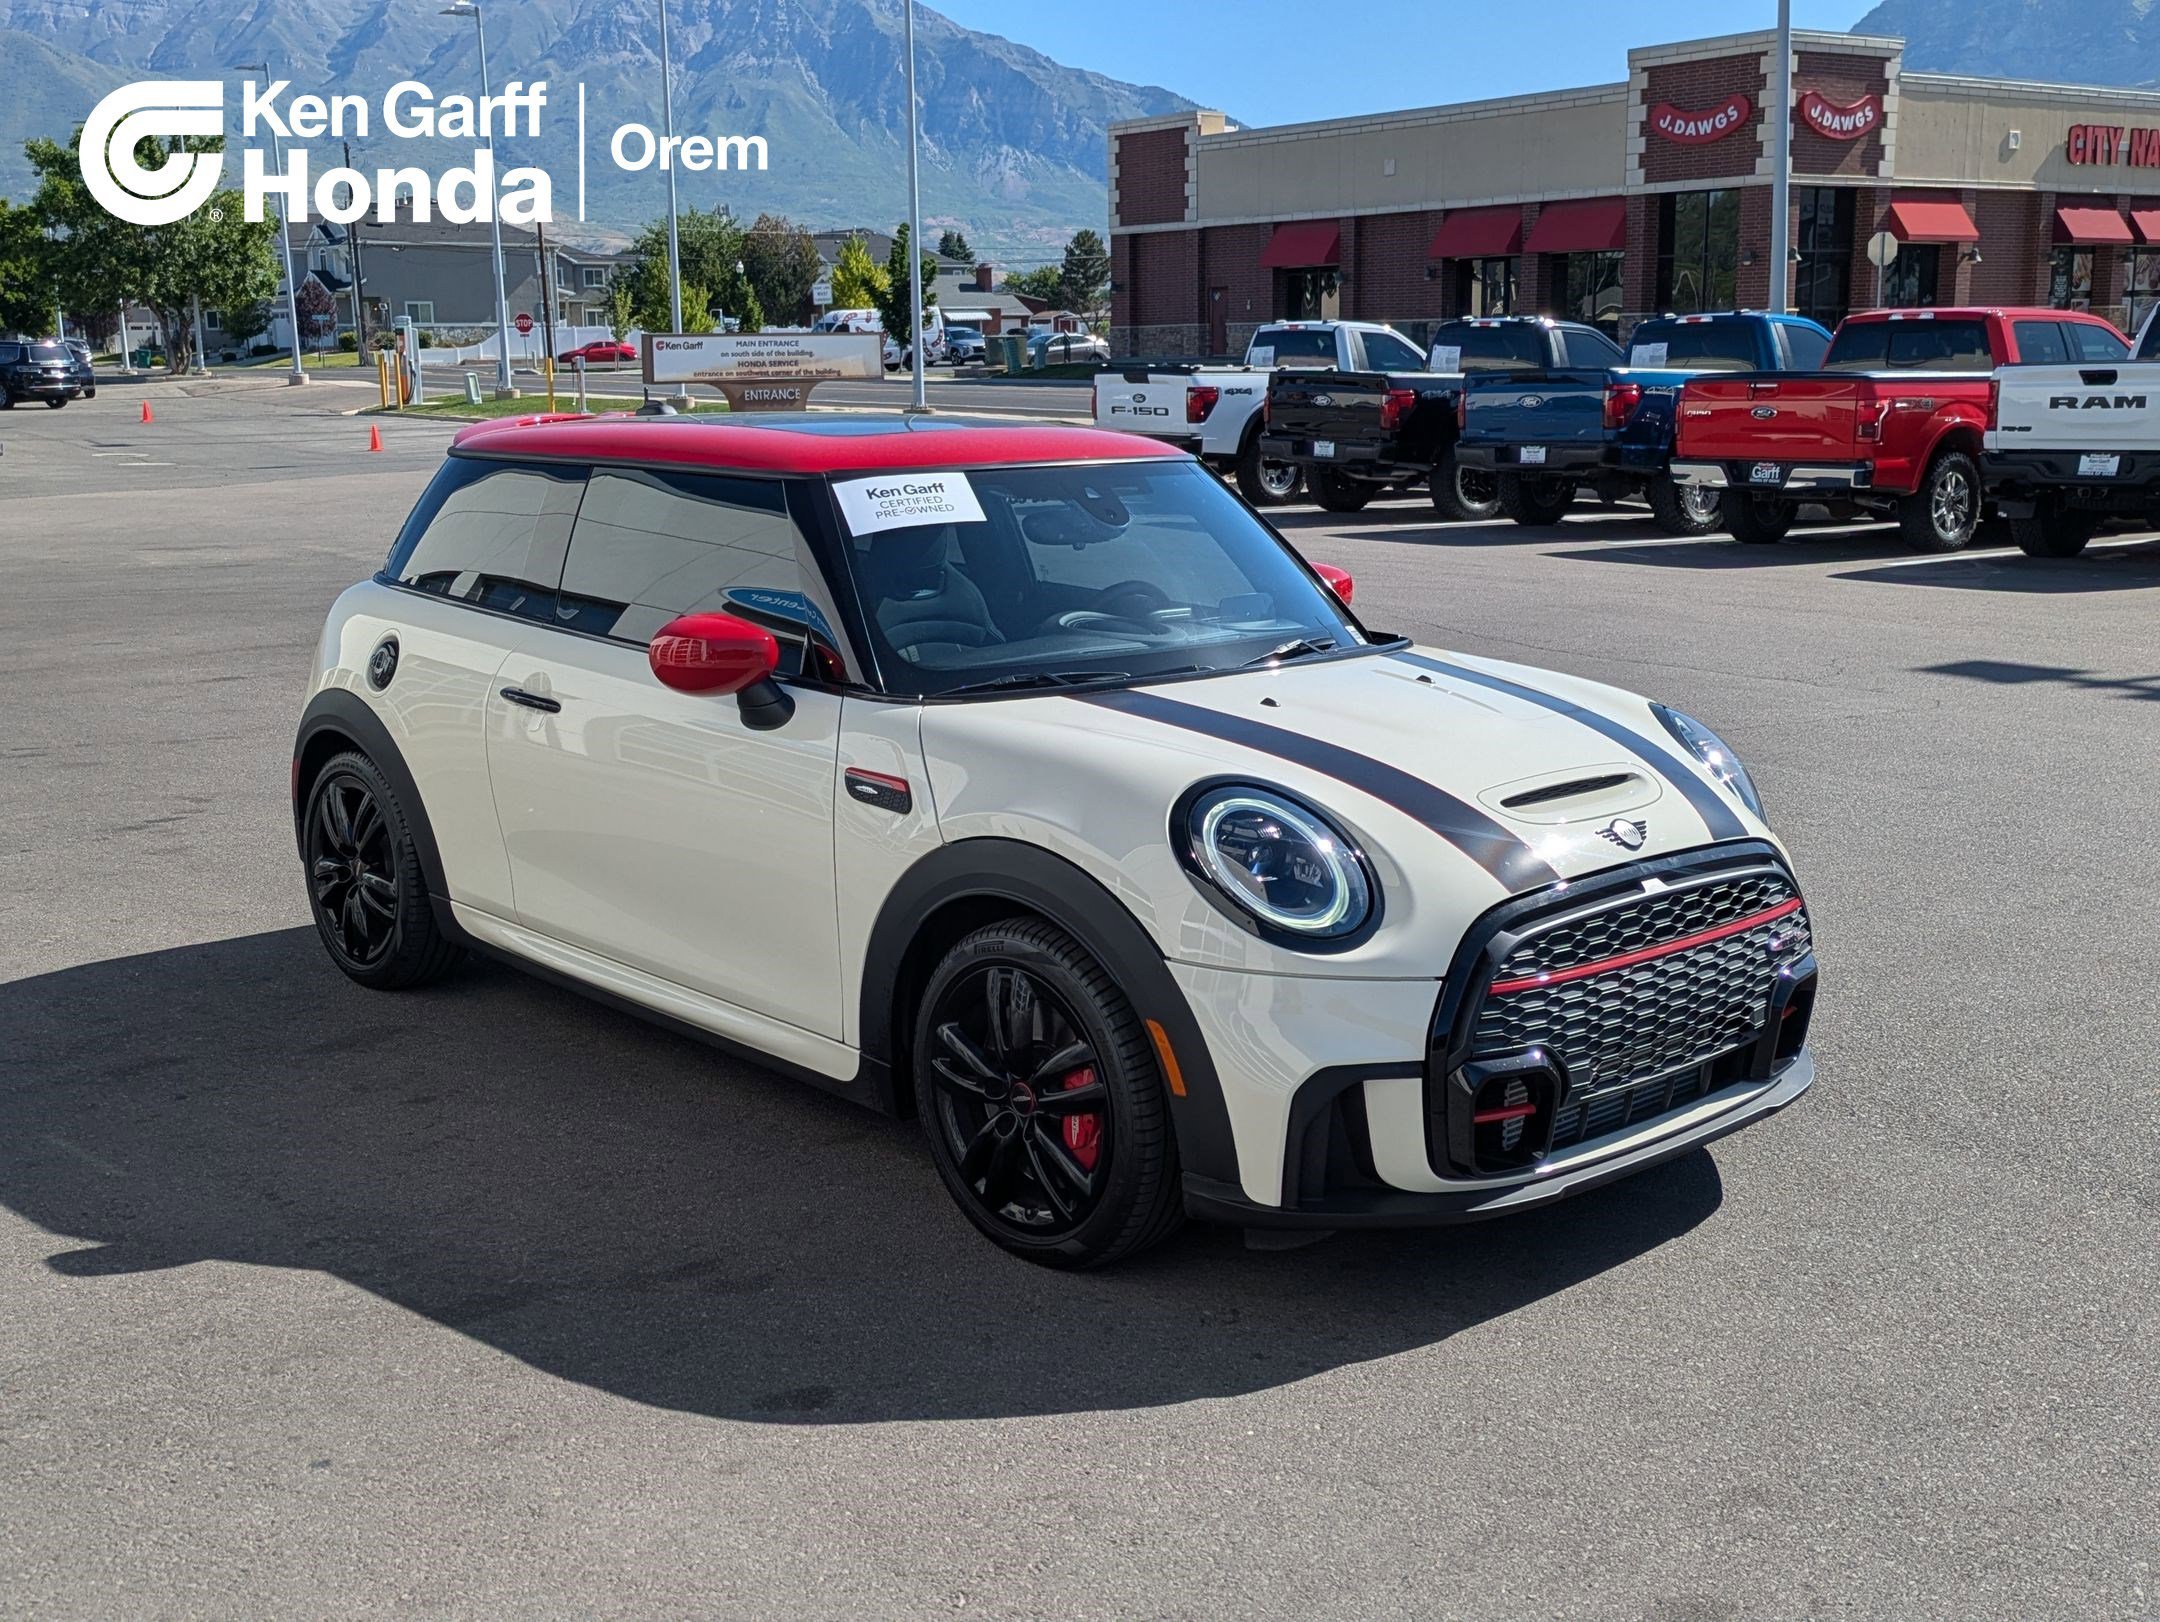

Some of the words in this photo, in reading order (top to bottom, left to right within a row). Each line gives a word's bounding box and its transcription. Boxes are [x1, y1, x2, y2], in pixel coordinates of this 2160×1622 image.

[1659, 106, 1738, 136] J.DAWGS
[1811, 104, 1874, 131] J.DAWGS
[2067, 124, 2124, 167] CITY
[516, 319, 532, 327] STOP
[665, 342, 682, 350] Ken
[682, 341, 704, 350] Garff
[731, 350, 750, 358] south
[738, 360, 767, 368] HONDA
[769, 359, 799, 367] SERVICE
[795, 368, 801, 376] of
[803, 368, 814, 376] the
[744, 388, 801, 401] ENTRANCE
[2049, 395, 2147, 410] RAM
[1111, 405, 1169, 416] F-150
[1752, 466, 1780, 479] Garff
[866, 487, 901, 500] Ken
[903, 482, 945, 495] Garff
[879, 495, 943, 510] CERTIFIED
